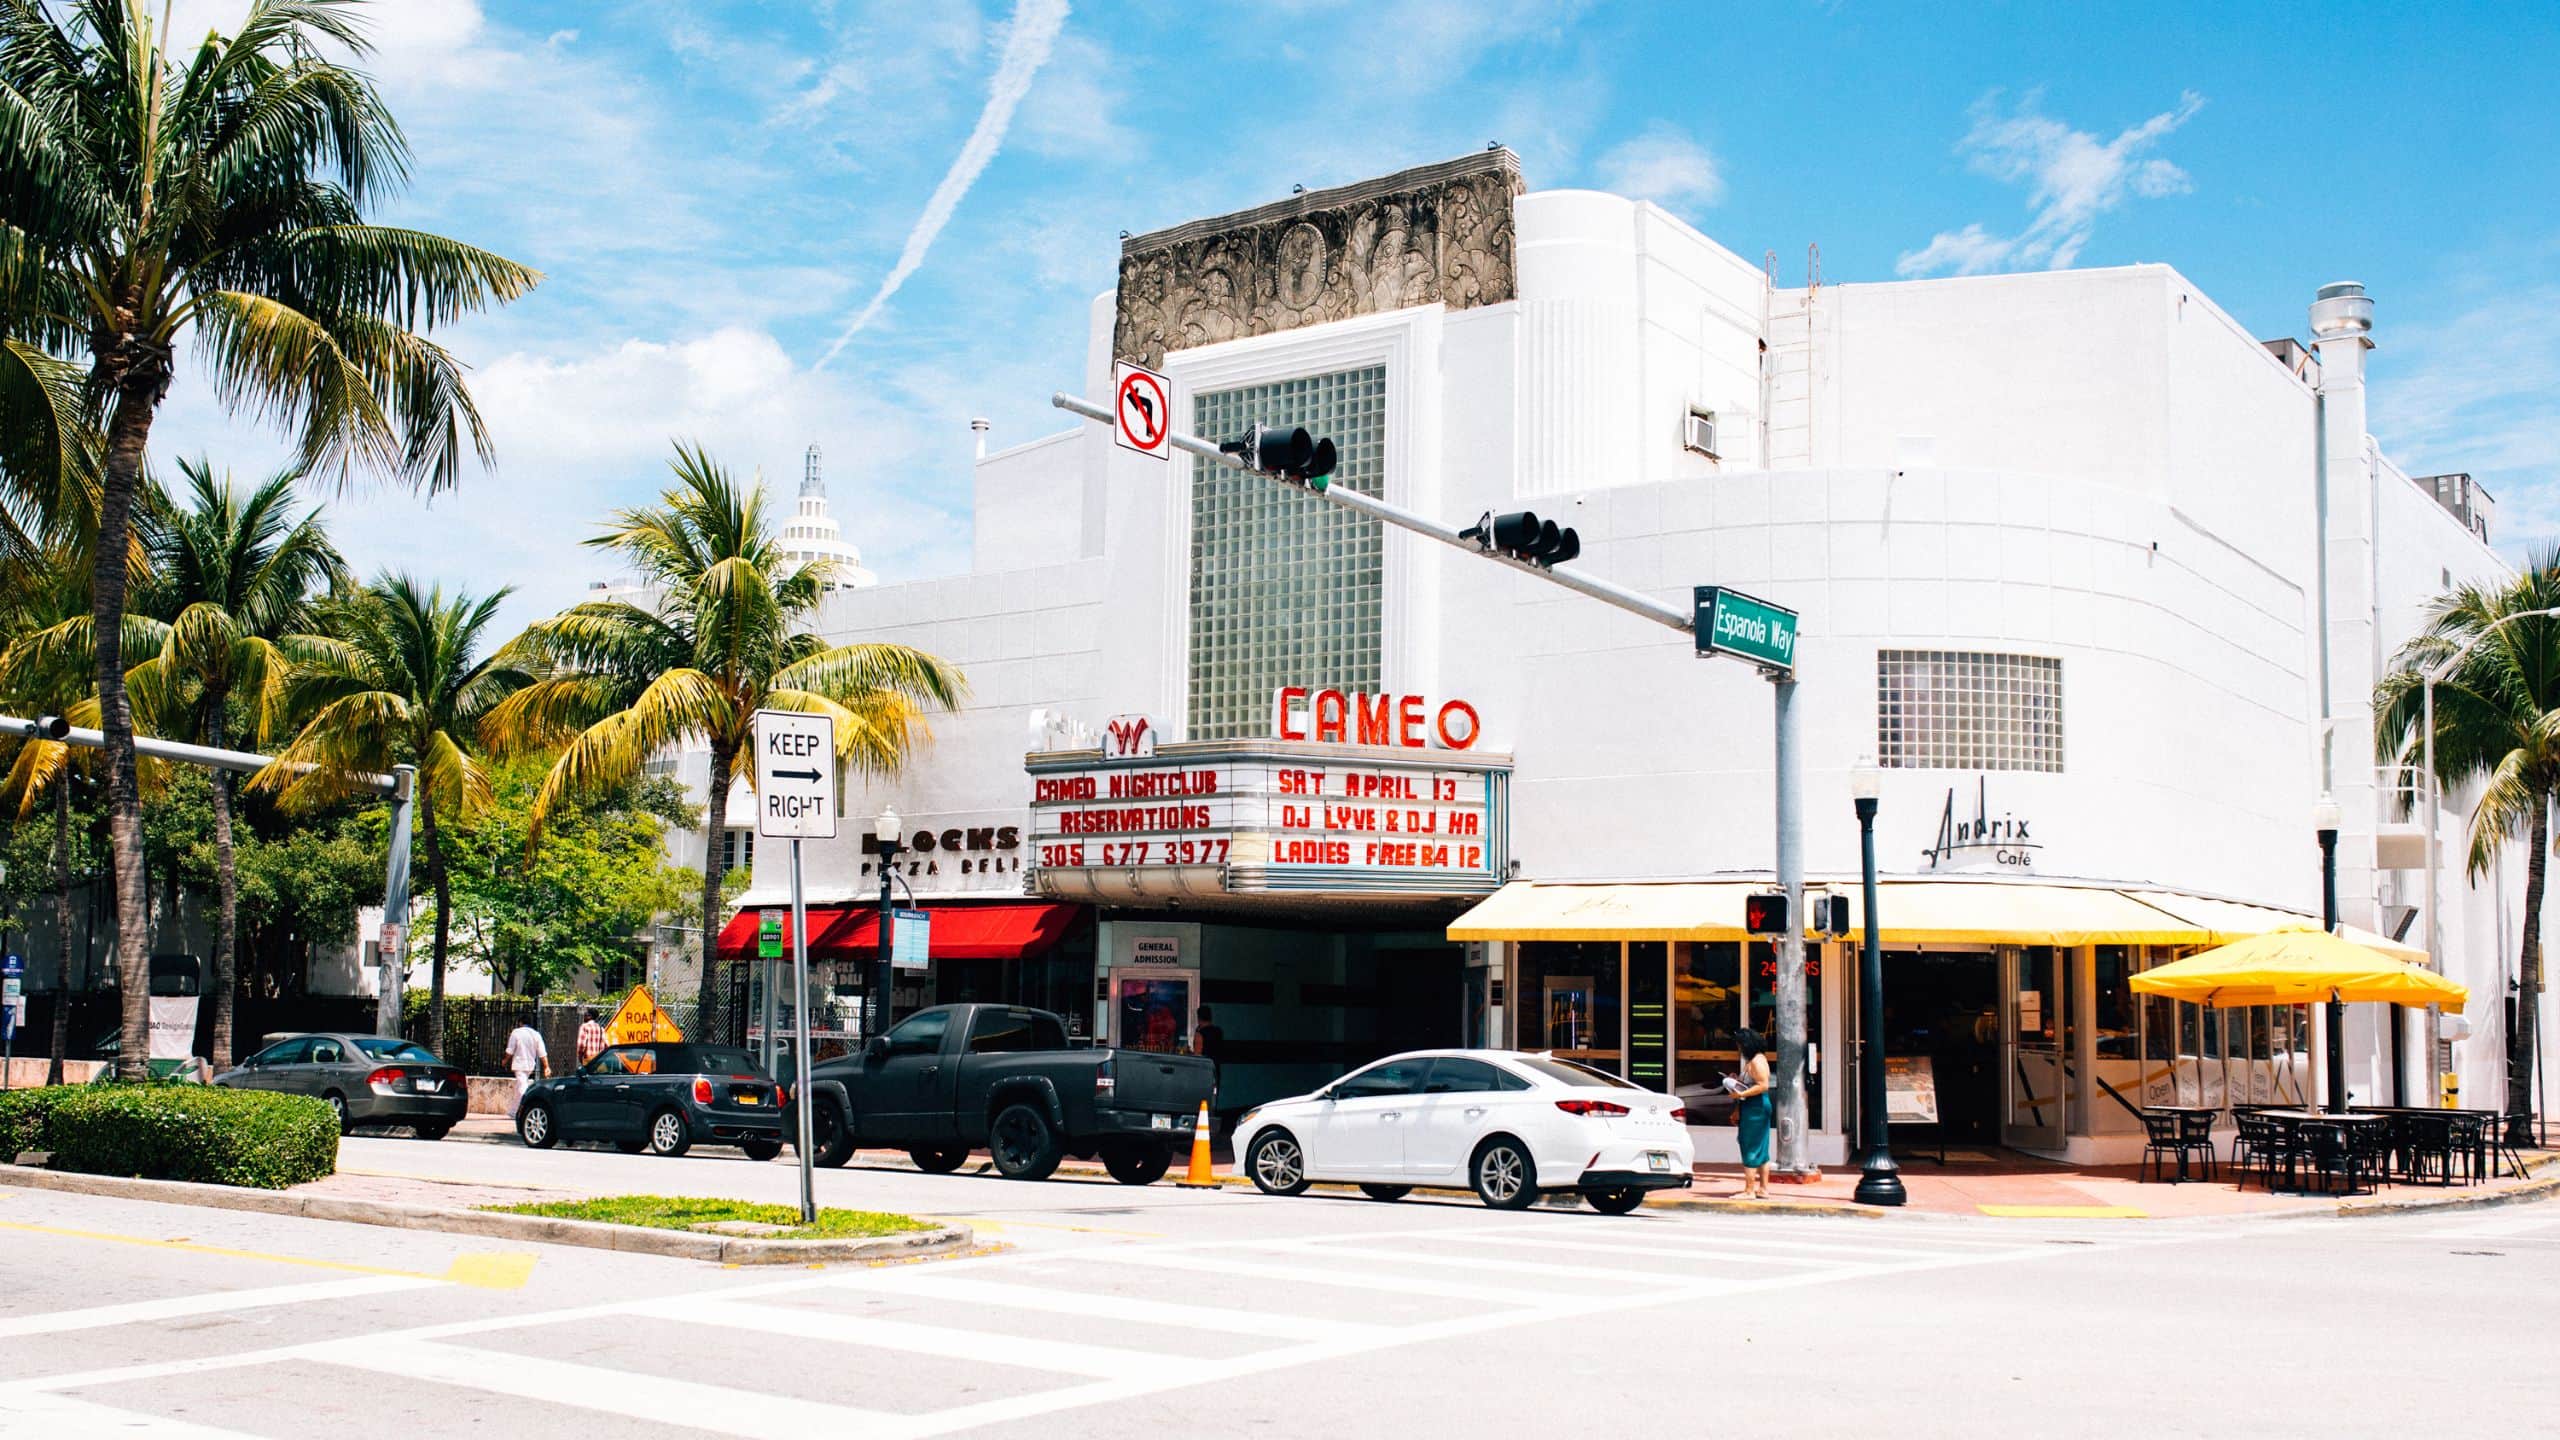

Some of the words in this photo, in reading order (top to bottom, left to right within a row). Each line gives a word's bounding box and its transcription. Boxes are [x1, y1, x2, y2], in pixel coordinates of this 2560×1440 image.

[1716, 603, 1766, 644] Espanola
[1771, 619, 1793, 658] Way
[1276, 686, 1481, 750] CAMEO
[769, 732, 820, 757] KEEP
[1108, 717, 1149, 755] W
[1035, 776, 1097, 801] CAMEO
[1109, 770, 1217, 799] NIGHTCLUB
[1278, 768, 1326, 795] SAT
[1345, 772, 1418, 800] APRIL
[1434, 777, 1456, 801] 13
[768, 794, 824, 818] RIGHT
[1060, 805, 1211, 834] RESERVATIONS
[1282, 805, 1311, 829] DJ
[1324, 805, 1376, 831] LYVE
[1386, 809, 1399, 832] &
[1406, 810, 1436, 833] DJ
[1921, 775, 2043, 868] Andrix
[1042, 844, 1083, 867] 305
[1103, 841, 1150, 866] 677
[1165, 839, 1230, 865] 3977
[1274, 839, 1350, 865] LADIES
[1366, 842, 1416, 866] FREE
[1459, 844, 1480, 868] 12
[1134, 955, 1178, 964] ADMISSION
[1138, 942, 1174, 952] GENERAL
[626, 1012, 654, 1024] ROAD
